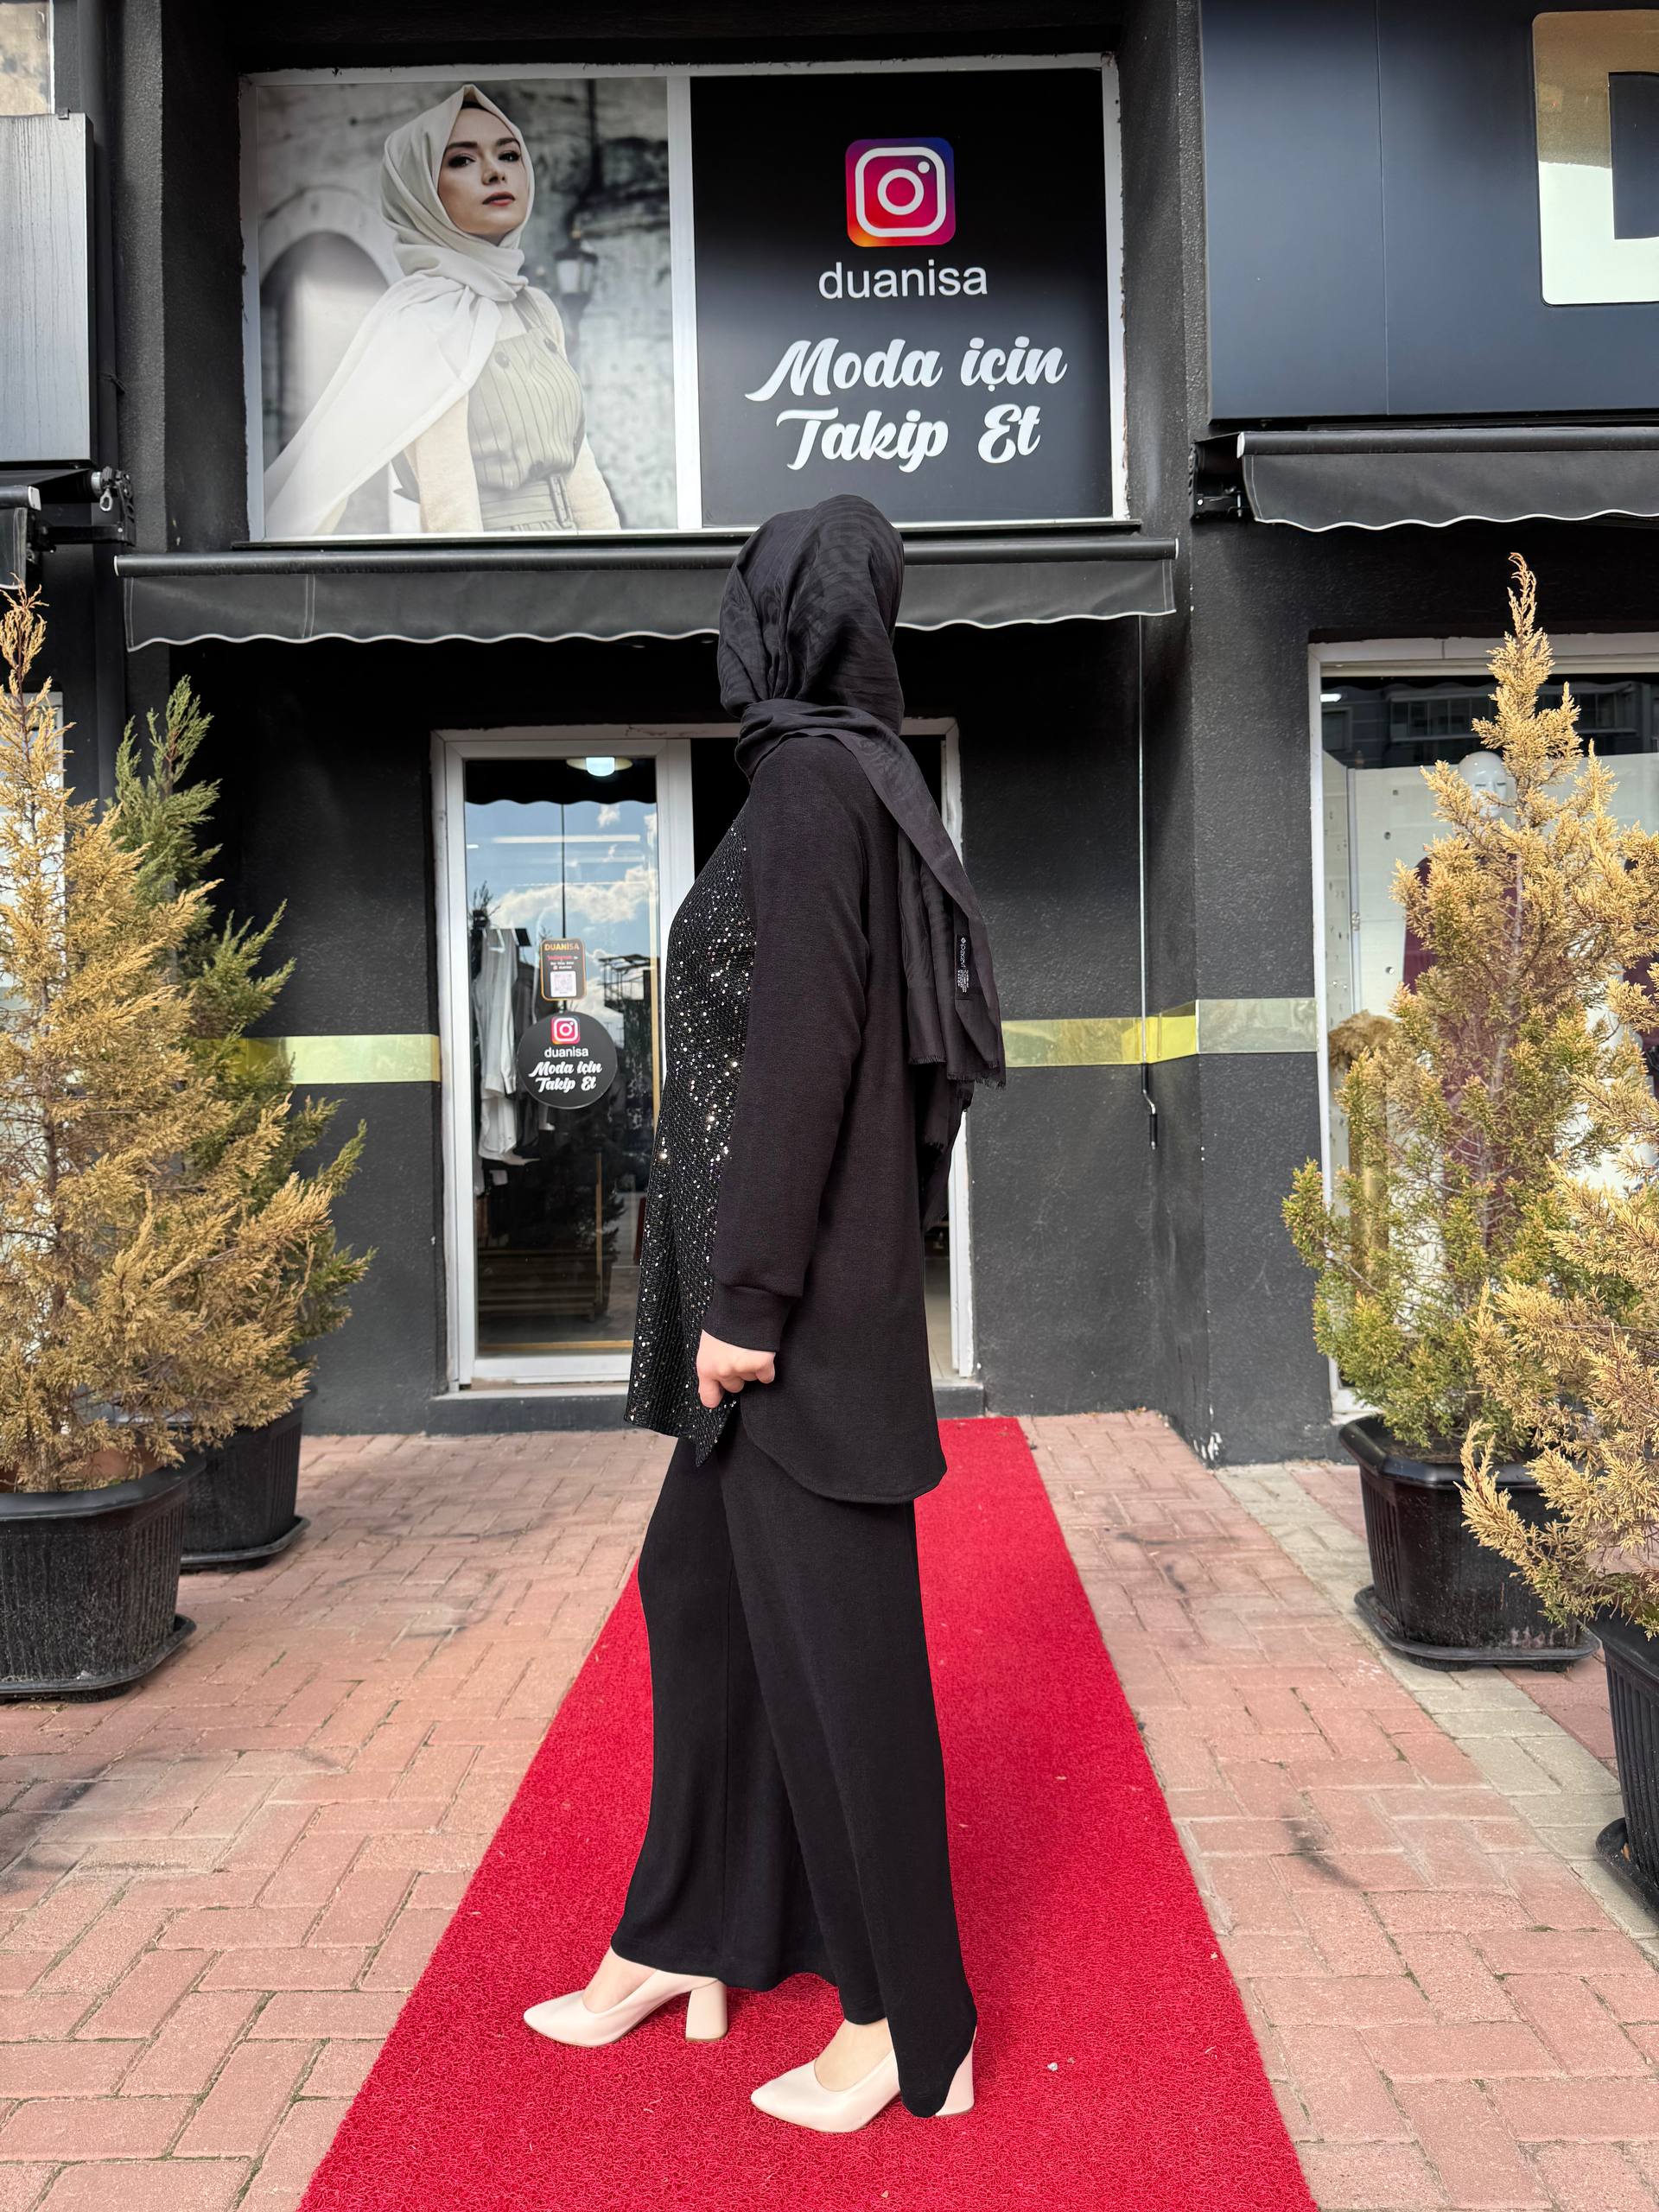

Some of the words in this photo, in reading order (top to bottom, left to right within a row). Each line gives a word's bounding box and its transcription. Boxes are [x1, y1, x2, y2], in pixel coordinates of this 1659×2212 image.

[818, 259, 988, 299] duanisa
[744, 337, 944, 402] Moda
[960, 336, 1068, 392] için
[775, 407, 949, 474] Takip
[977, 404, 1041, 464] Et
[543, 1046, 589, 1058] duanisa
[528, 1061, 574, 1078] Moda
[576, 1060, 603, 1076] için
[535, 1077, 576, 1094] Takip
[581, 1076, 597, 1091] Et
